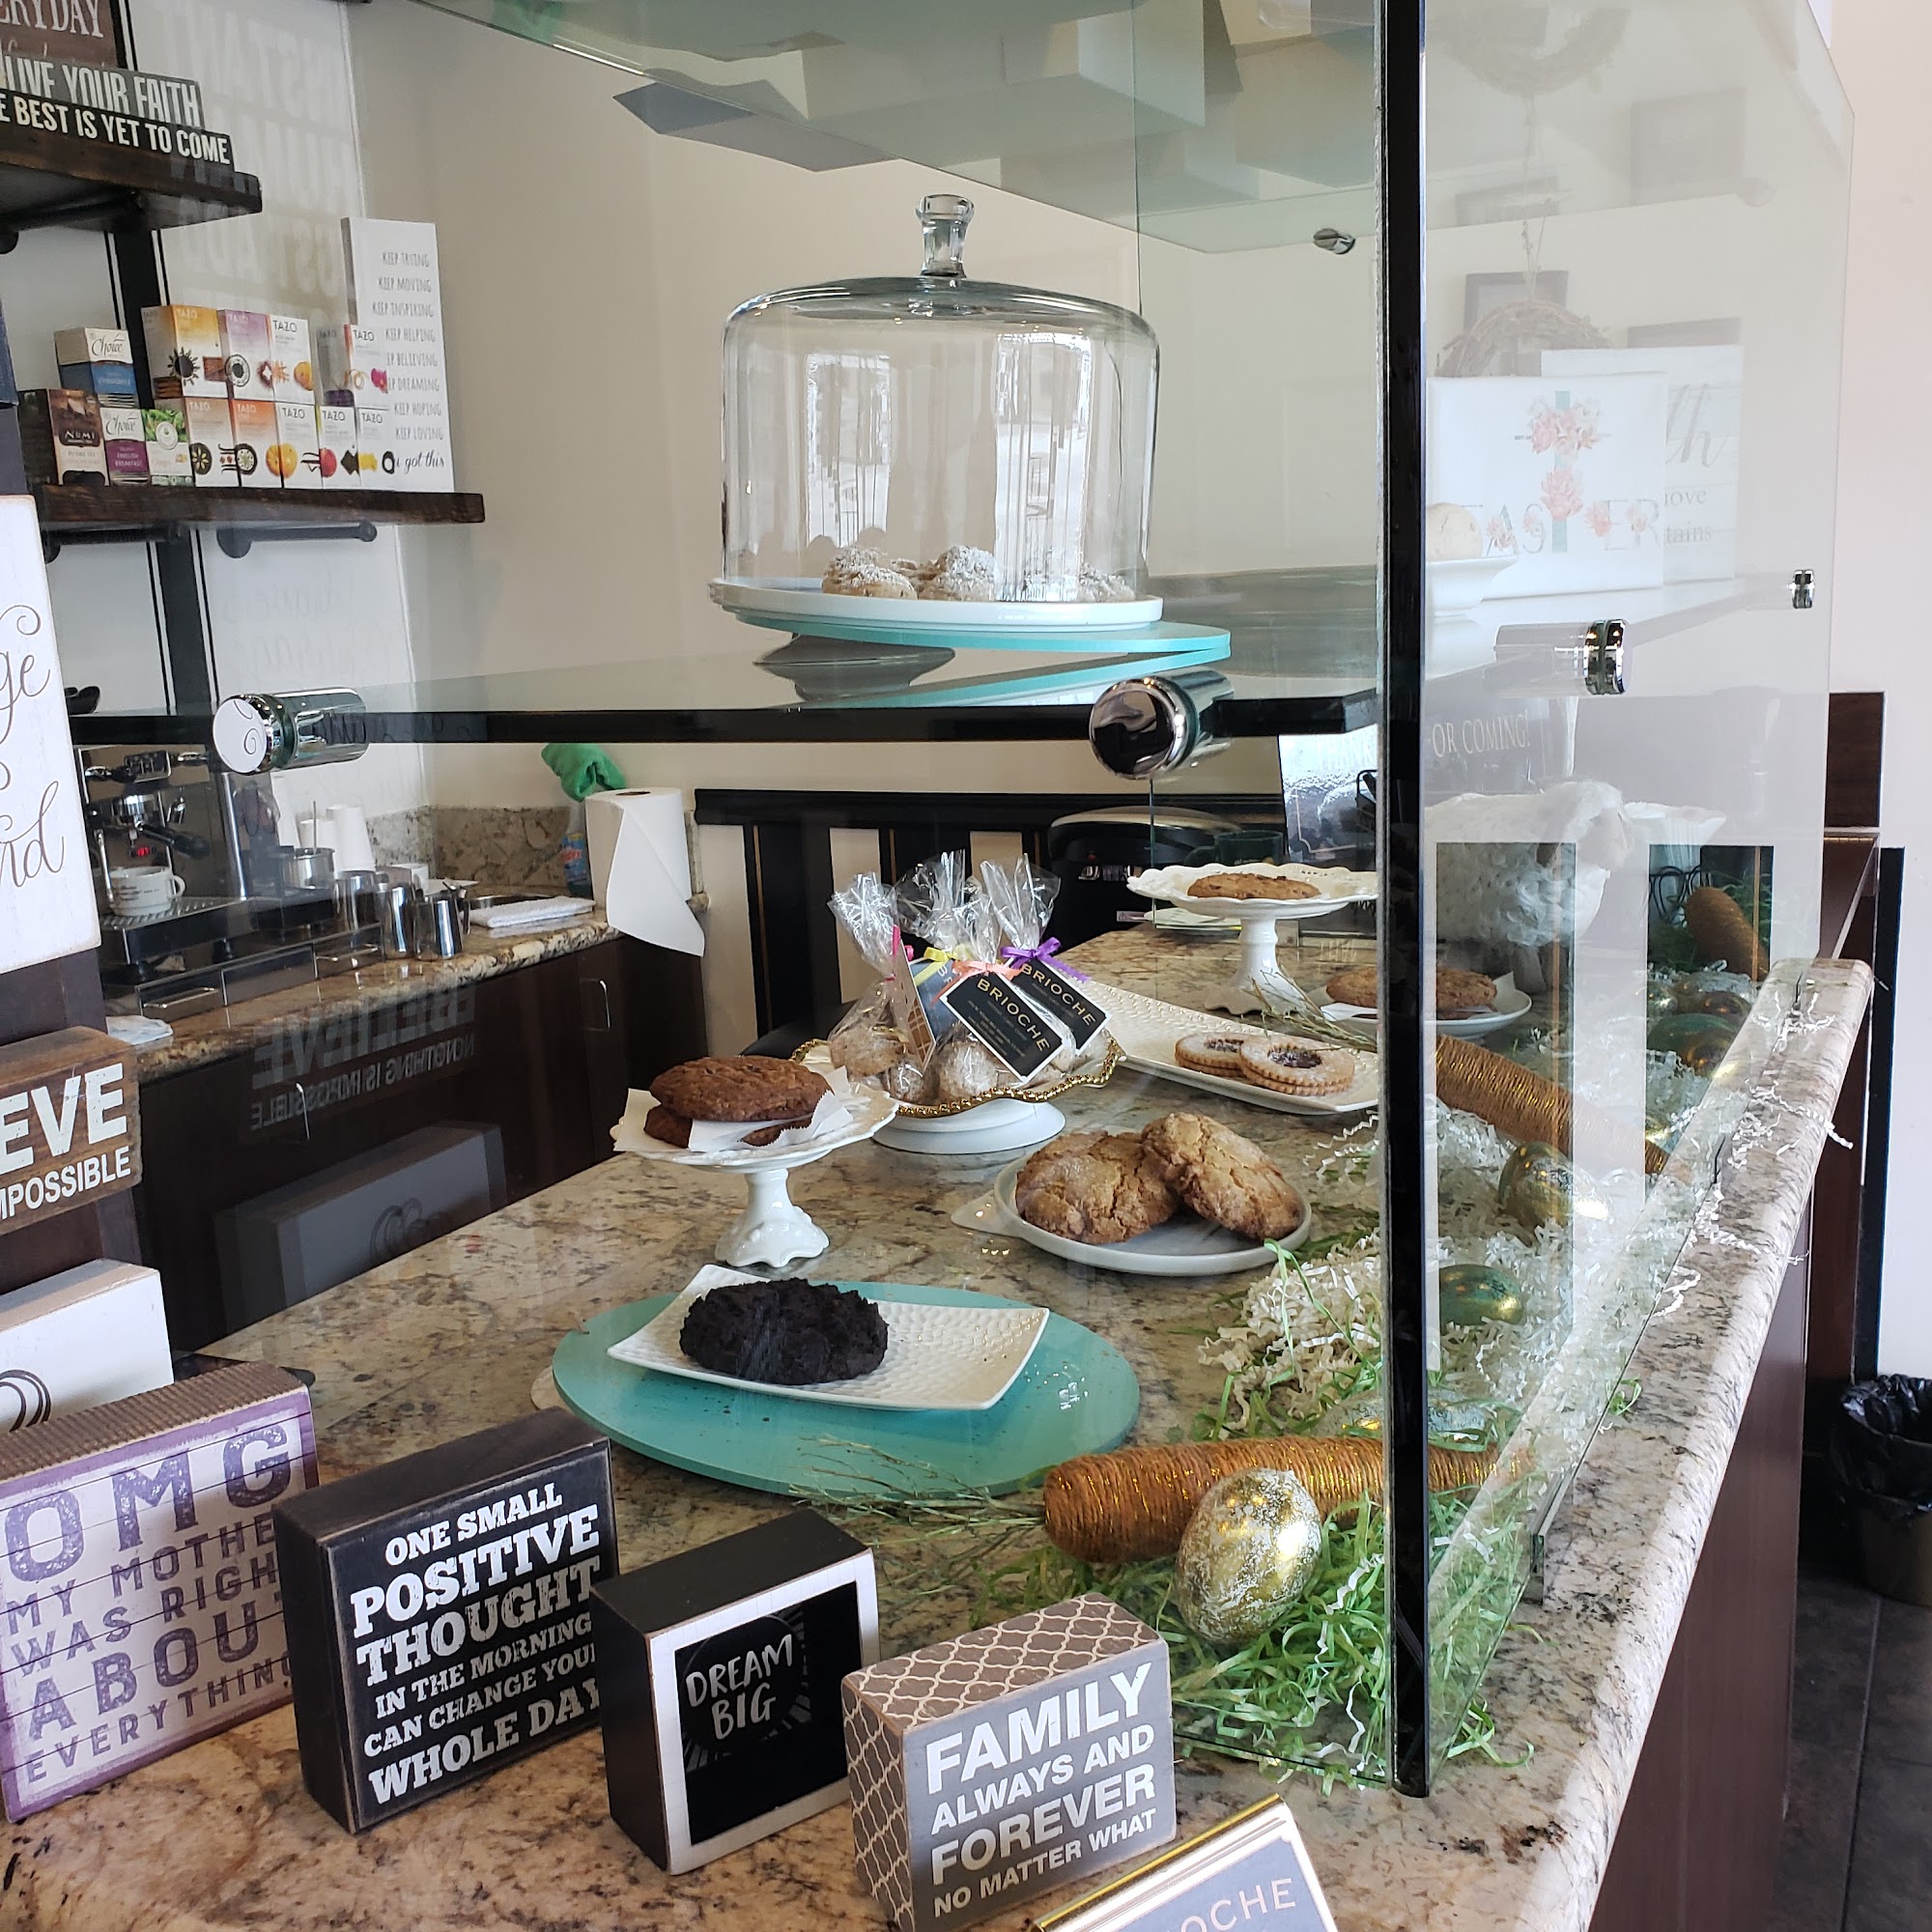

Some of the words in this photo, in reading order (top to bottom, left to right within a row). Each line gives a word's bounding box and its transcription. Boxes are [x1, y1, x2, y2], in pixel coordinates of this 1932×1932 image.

[62, 64, 130, 115] YOUR
[133, 75, 201, 127] FAITH
[14, 95, 69, 133] BEST
[75, 108, 98, 139] IS
[101, 114, 140, 147] YET
[145, 124, 173, 154] TO
[176, 129, 231, 165] COME
[378, 276, 395, 291] KEEP
[397, 277, 432, 293] MOVING
[383, 251, 399, 266] KEEP
[401, 252, 430, 268] TRYING
[177, 308, 197, 320] TAZO
[272, 320, 298, 332] TAZO
[353, 329, 375, 342] TAZO
[372, 301, 388, 316] KEEP
[390, 302, 434, 318] INSPIRING
[385, 327, 401, 342] KEEP
[404, 328, 436, 343] HELPING
[92, 334, 125, 356] Choice
[397, 353, 439, 367] BELIEVING
[188, 401, 211, 412] TAZO
[282, 407, 305, 419] TAZO
[394, 403, 411, 415] KEEP
[397, 378, 440, 392] DREAMING
[105, 412, 139, 435] Choice
[322, 410, 346, 421] TAZO
[361, 412, 384, 423] TAZO
[395, 427, 411, 440] KEEP
[406, 451, 422, 474] got
[425, 450, 444, 468] this
[977, 978, 1050, 1052] BRIOCHE
[1020, 962, 1095, 1026] BRIOCHE
[5, 1424, 290, 1582] OMG
[385, 1520, 451, 1566] ONE
[457, 1483, 563, 1542] SMALL
[351, 1504, 600, 1638] POSITIVE
[6, 1578, 77, 1636] MY
[355, 1555, 600, 1688] THOUGHT
[11, 1605, 132, 1678] WAS
[29, 1591, 282, 1740] ABOU
[376, 1686, 407, 1719] IN
[412, 1662, 465, 1703] THE
[470, 1612, 592, 1680] MORNING
[686, 1634, 792, 1707] DREAM
[363, 1715, 422, 1757] CAN
[429, 1667, 537, 1730] CHANGE
[541, 1642, 596, 1680] YOU
[711, 1682, 777, 1740] BIG
[925, 1662, 1152, 1795] FAMILY
[368, 1711, 520, 1804] WHOLE
[931, 1754, 1074, 1835] ALWAYS
[1084, 1724, 1154, 1774] AND
[931, 1763, 1156, 1886] FOREVER
[934, 1886, 972, 1918] NO
[980, 1839, 1082, 1899] MATTER
[1088, 1807, 1157, 1852] WHAT
